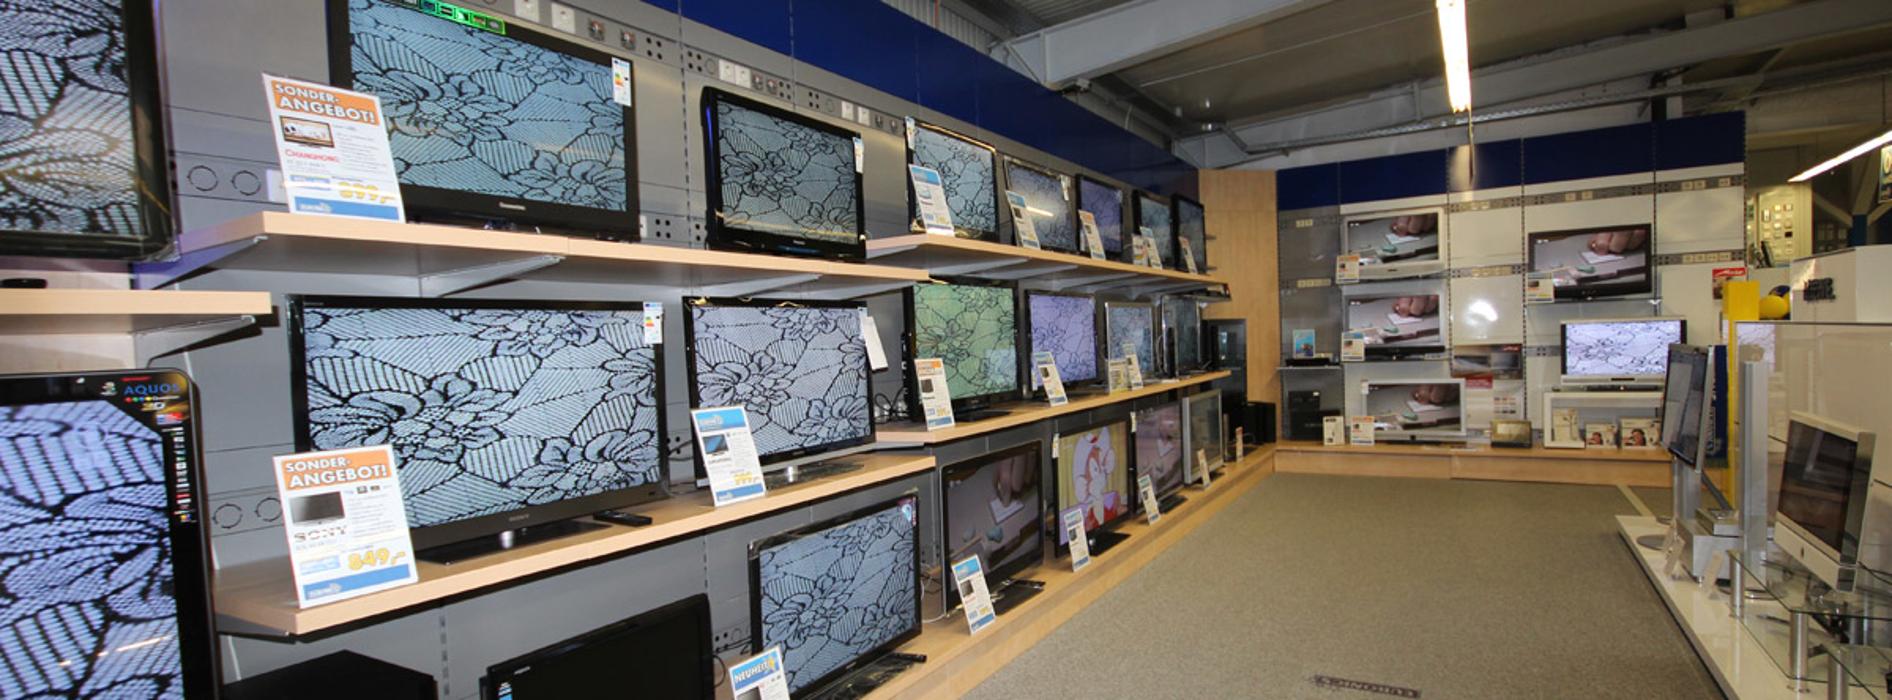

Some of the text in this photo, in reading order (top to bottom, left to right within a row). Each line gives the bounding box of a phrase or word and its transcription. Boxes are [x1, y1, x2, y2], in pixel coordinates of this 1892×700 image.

[276, 83, 339, 102] SONDER-
[280, 96, 375, 123] ANGEBOT!
[124, 383, 179, 396] AQUOS
[285, 456, 351, 473] SONDER-
[289, 464, 388, 488] ANGEBOT!
[294, 525, 348, 543] SONY
